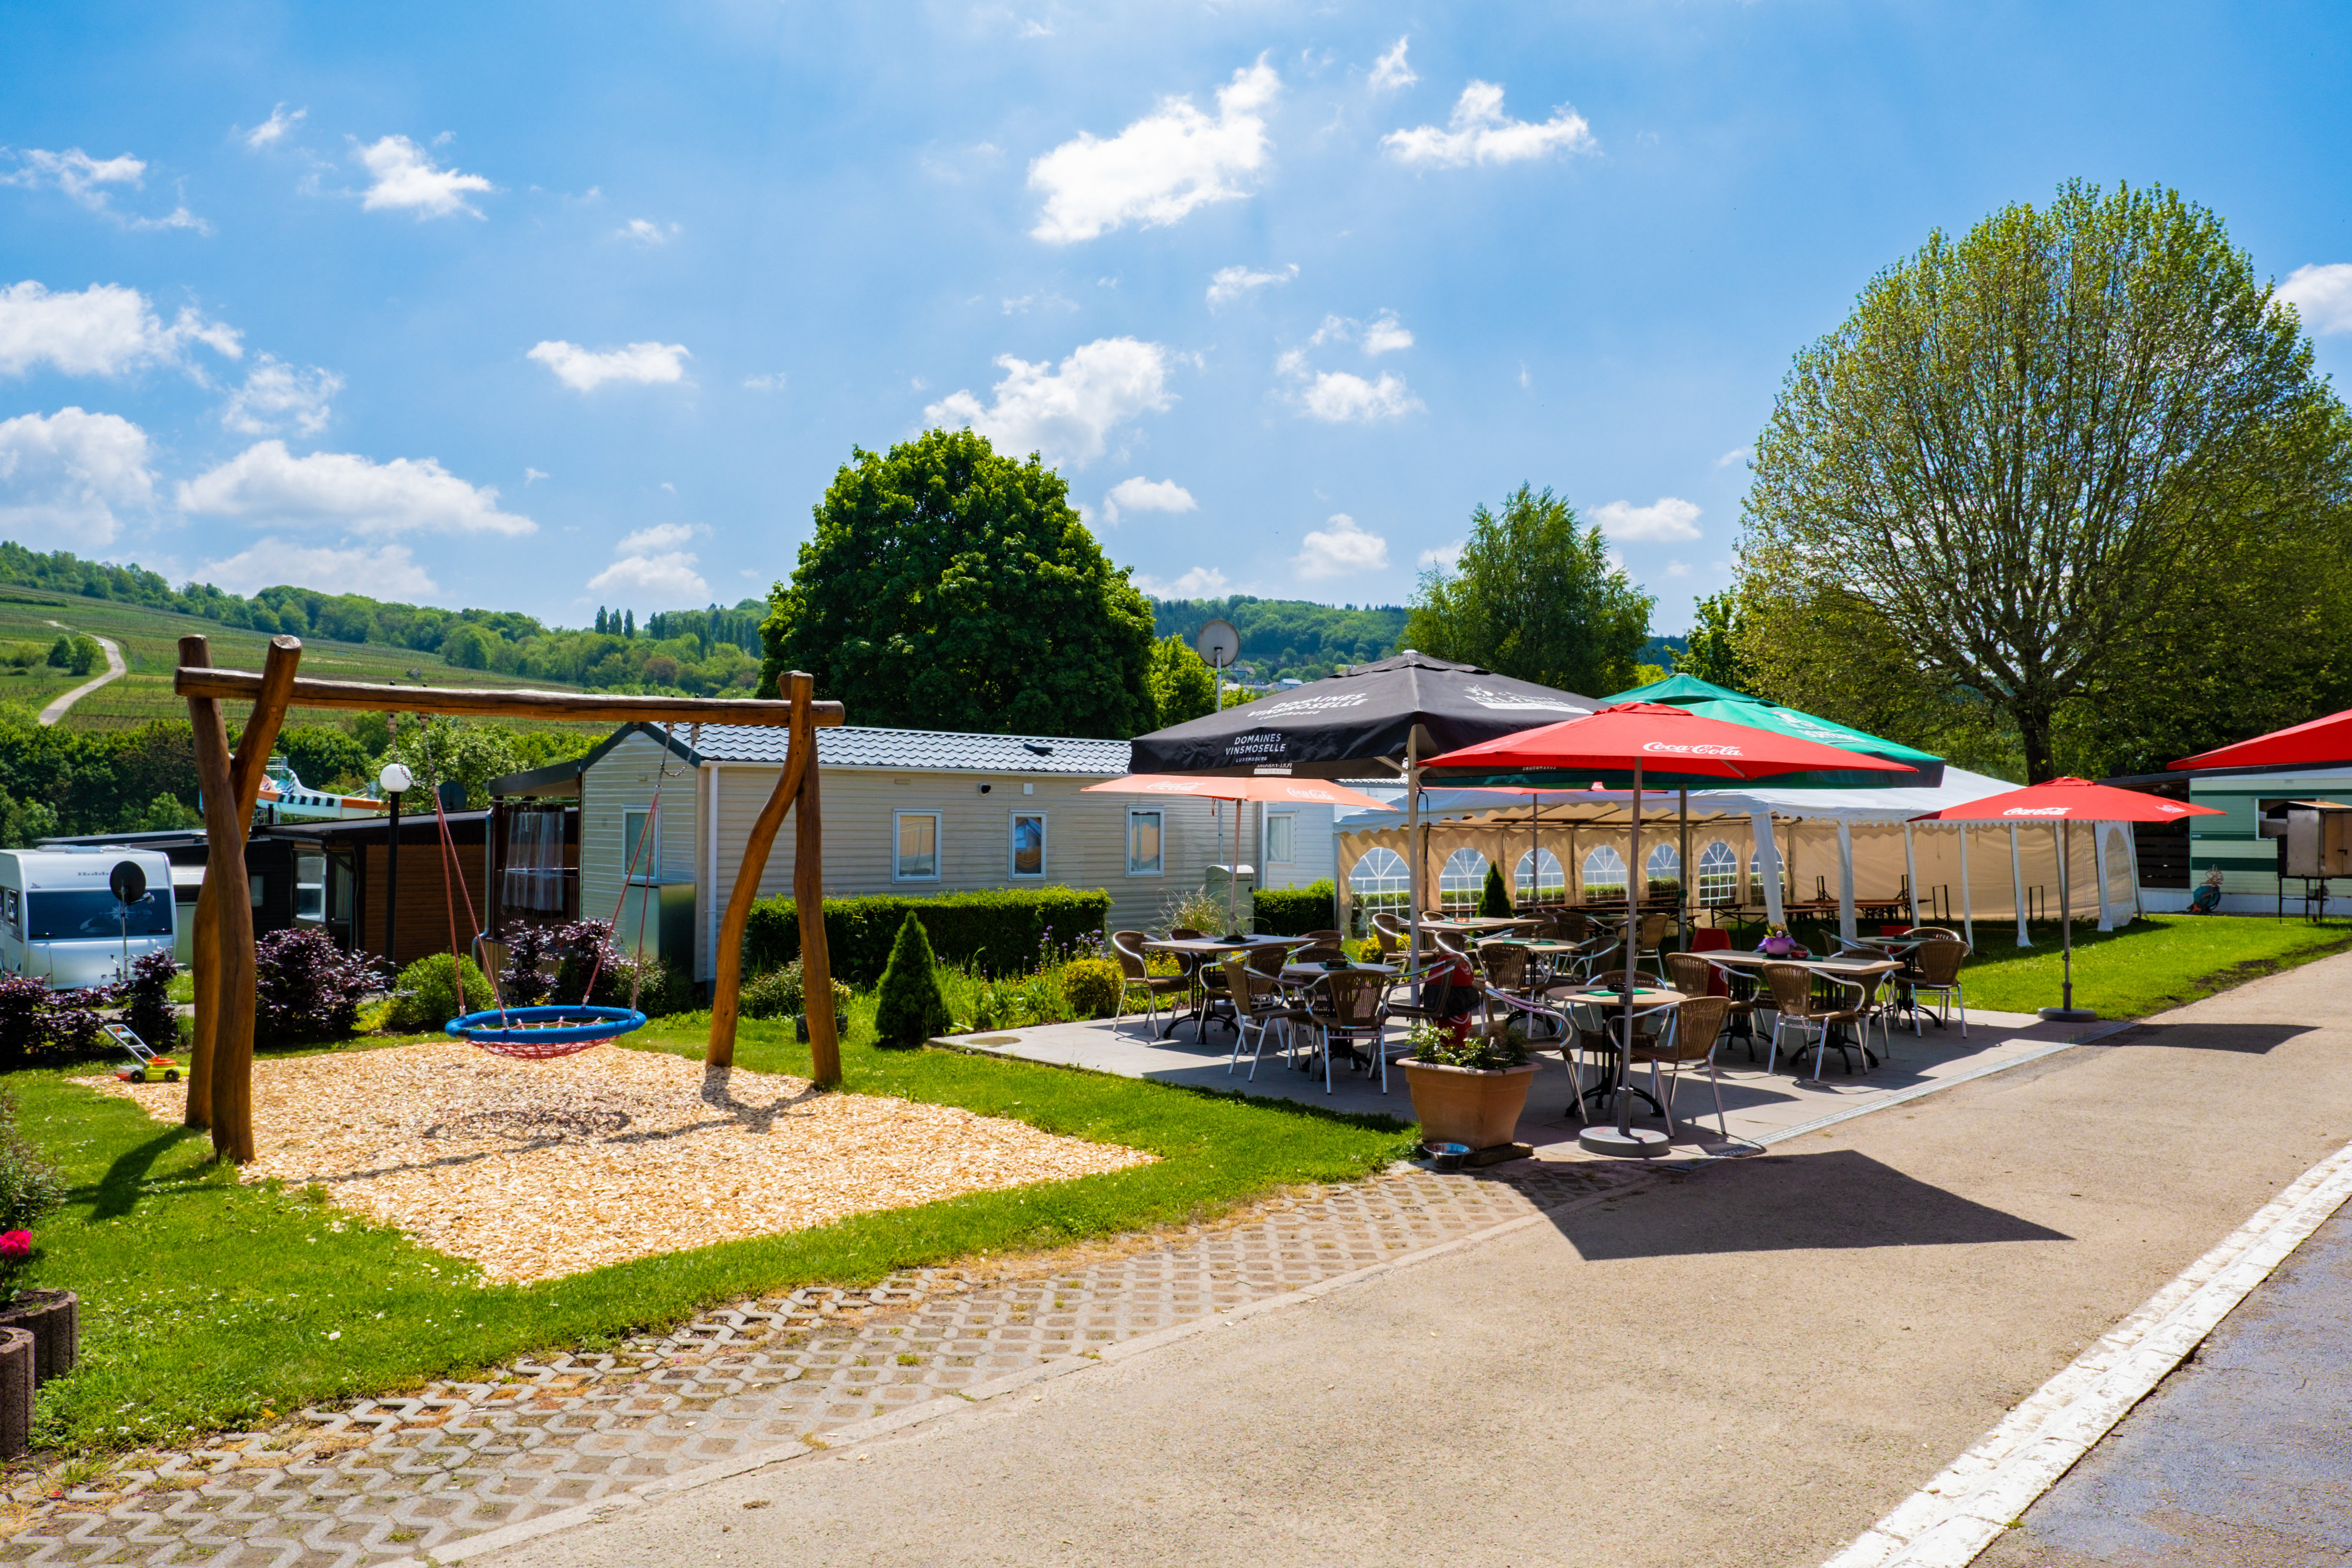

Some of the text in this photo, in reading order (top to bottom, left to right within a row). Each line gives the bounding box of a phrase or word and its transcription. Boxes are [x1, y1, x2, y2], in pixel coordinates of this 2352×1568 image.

[1247, 698, 1369, 717] VINSMOSELLE
[1272, 693, 1367, 709] DOMAINES
[1234, 733, 1281, 745] DOMAINES
[1225, 744, 1287, 755] VINSMOSELLE
[1643, 742, 1741, 756] Coca-Cola
